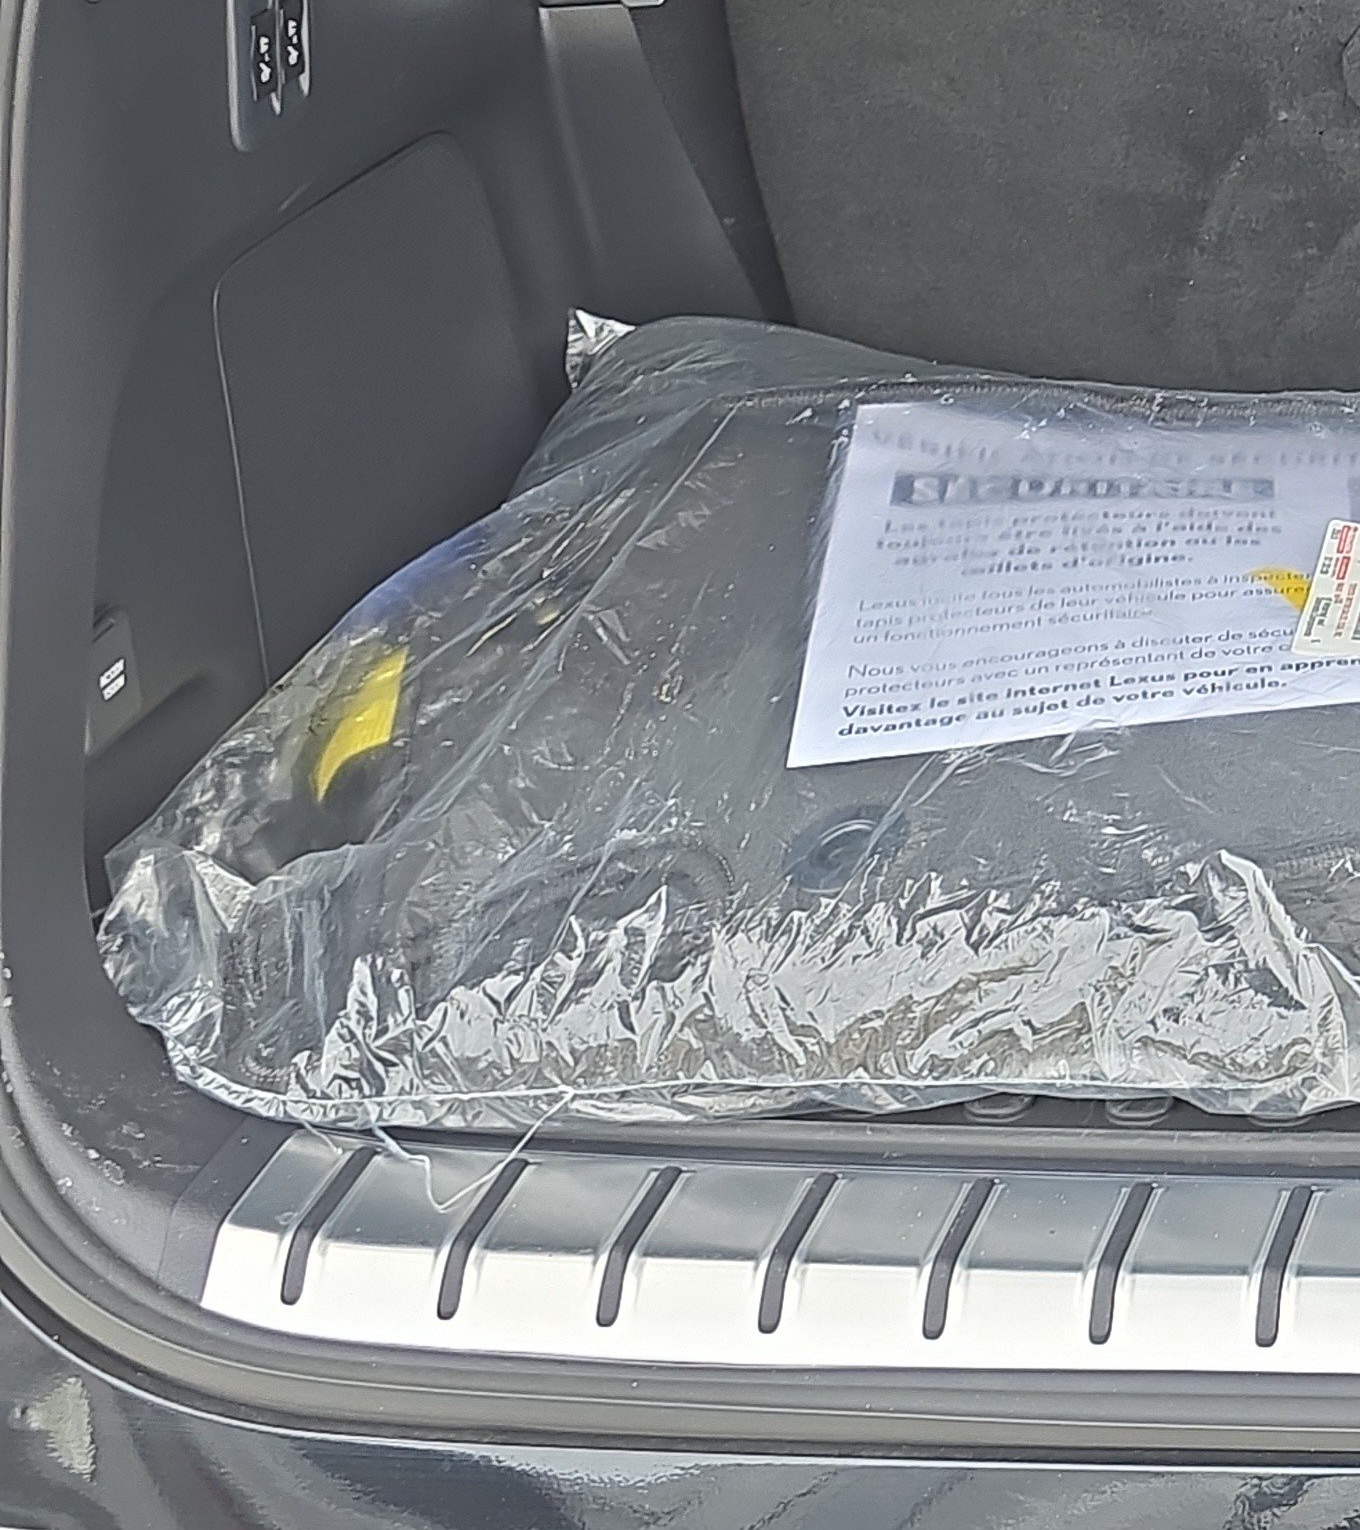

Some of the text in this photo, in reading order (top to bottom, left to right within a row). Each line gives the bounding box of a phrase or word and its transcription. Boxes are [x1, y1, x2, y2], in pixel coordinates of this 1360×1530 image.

[1029, 598, 1056, 612] de
[1060, 595, 1098, 609] leur
[1190, 587, 1236, 603] pour
[843, 676, 966, 699] protecteurs
[970, 668, 1019, 683] avec
[1023, 665, 1050, 676] un
[1054, 648, 1185, 675] représentant
[1190, 646, 1217, 660] de
[1221, 642, 1274, 657] votre
[847, 664, 904, 678] Nous
[961, 642, 1109, 669] encourageons
[1217, 628, 1244, 643] de
[837, 677, 1288, 737] davantage au sujet de votre véhicule.
[842, 700, 923, 718] Visitez
[929, 696, 950, 710] le
[956, 691, 999, 707] site
[1005, 677, 1102, 699] internet
[1108, 672, 1176, 688] Lexus
[1183, 666, 1242, 683] pour
[1245, 664, 1274, 676] en
